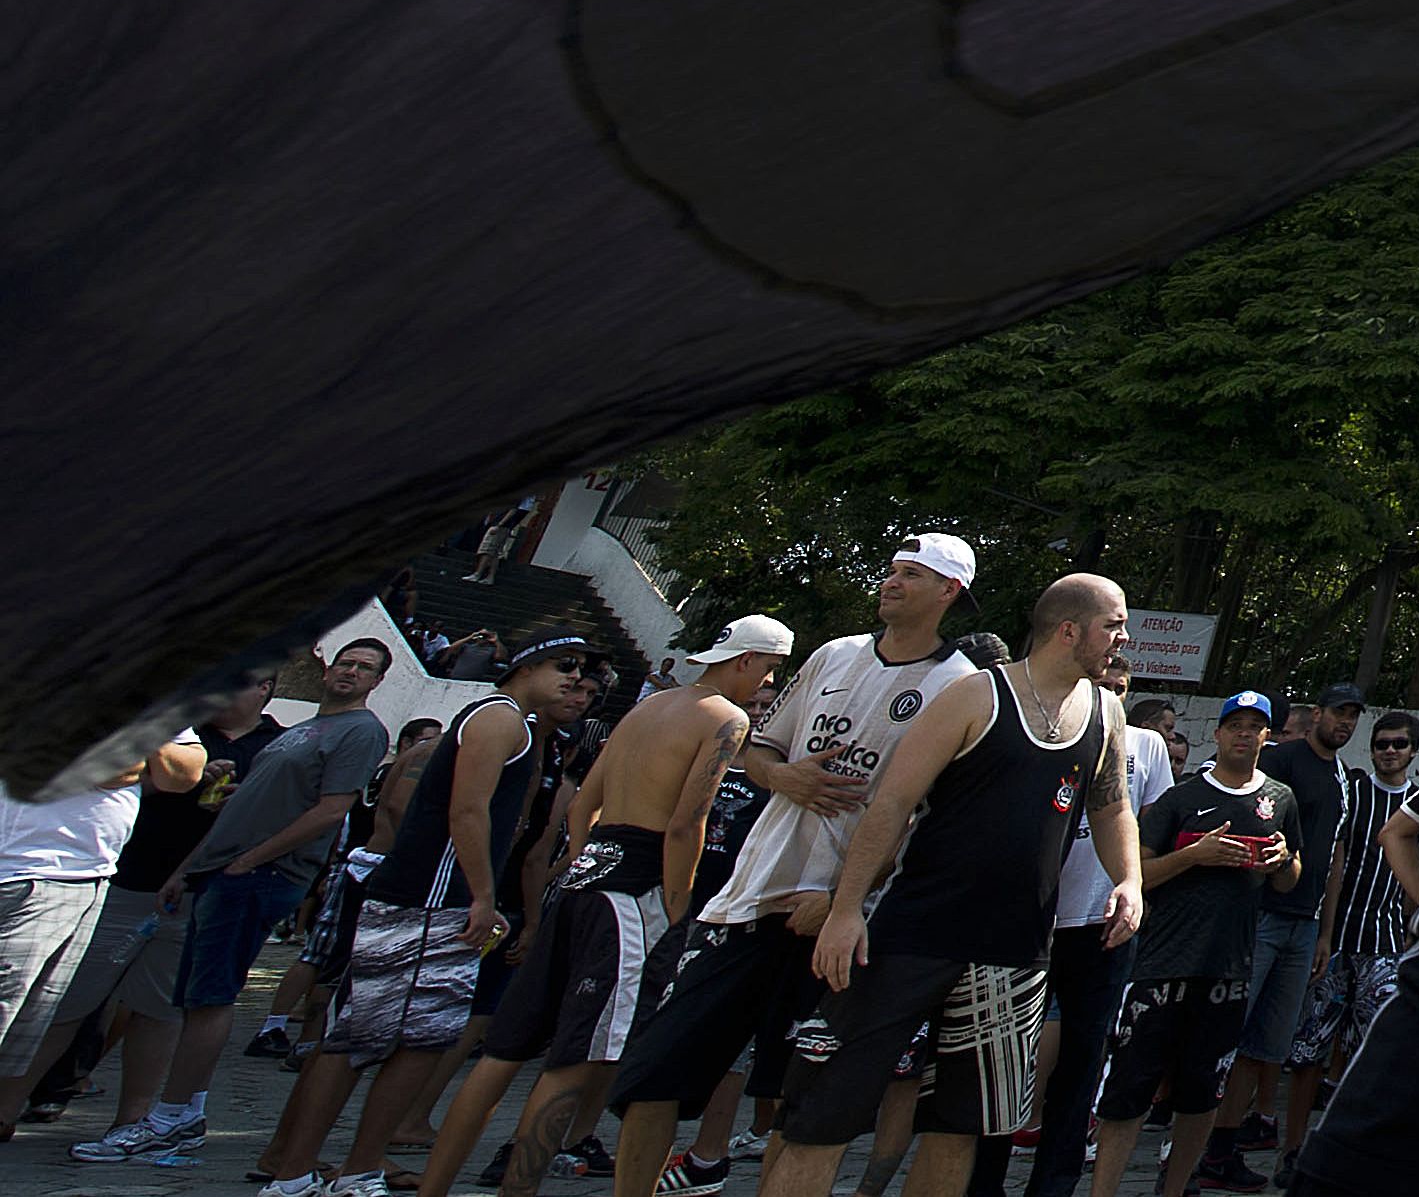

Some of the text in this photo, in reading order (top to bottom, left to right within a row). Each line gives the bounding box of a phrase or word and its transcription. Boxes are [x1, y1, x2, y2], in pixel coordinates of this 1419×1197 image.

[1141, 617, 1184, 634] ATENÇÃO
[1138, 640, 1180, 657] promoção
[1180, 644, 1201, 656] para
[719, 781, 755, 799] VIÕES
[704, 844, 728, 854] IEL
